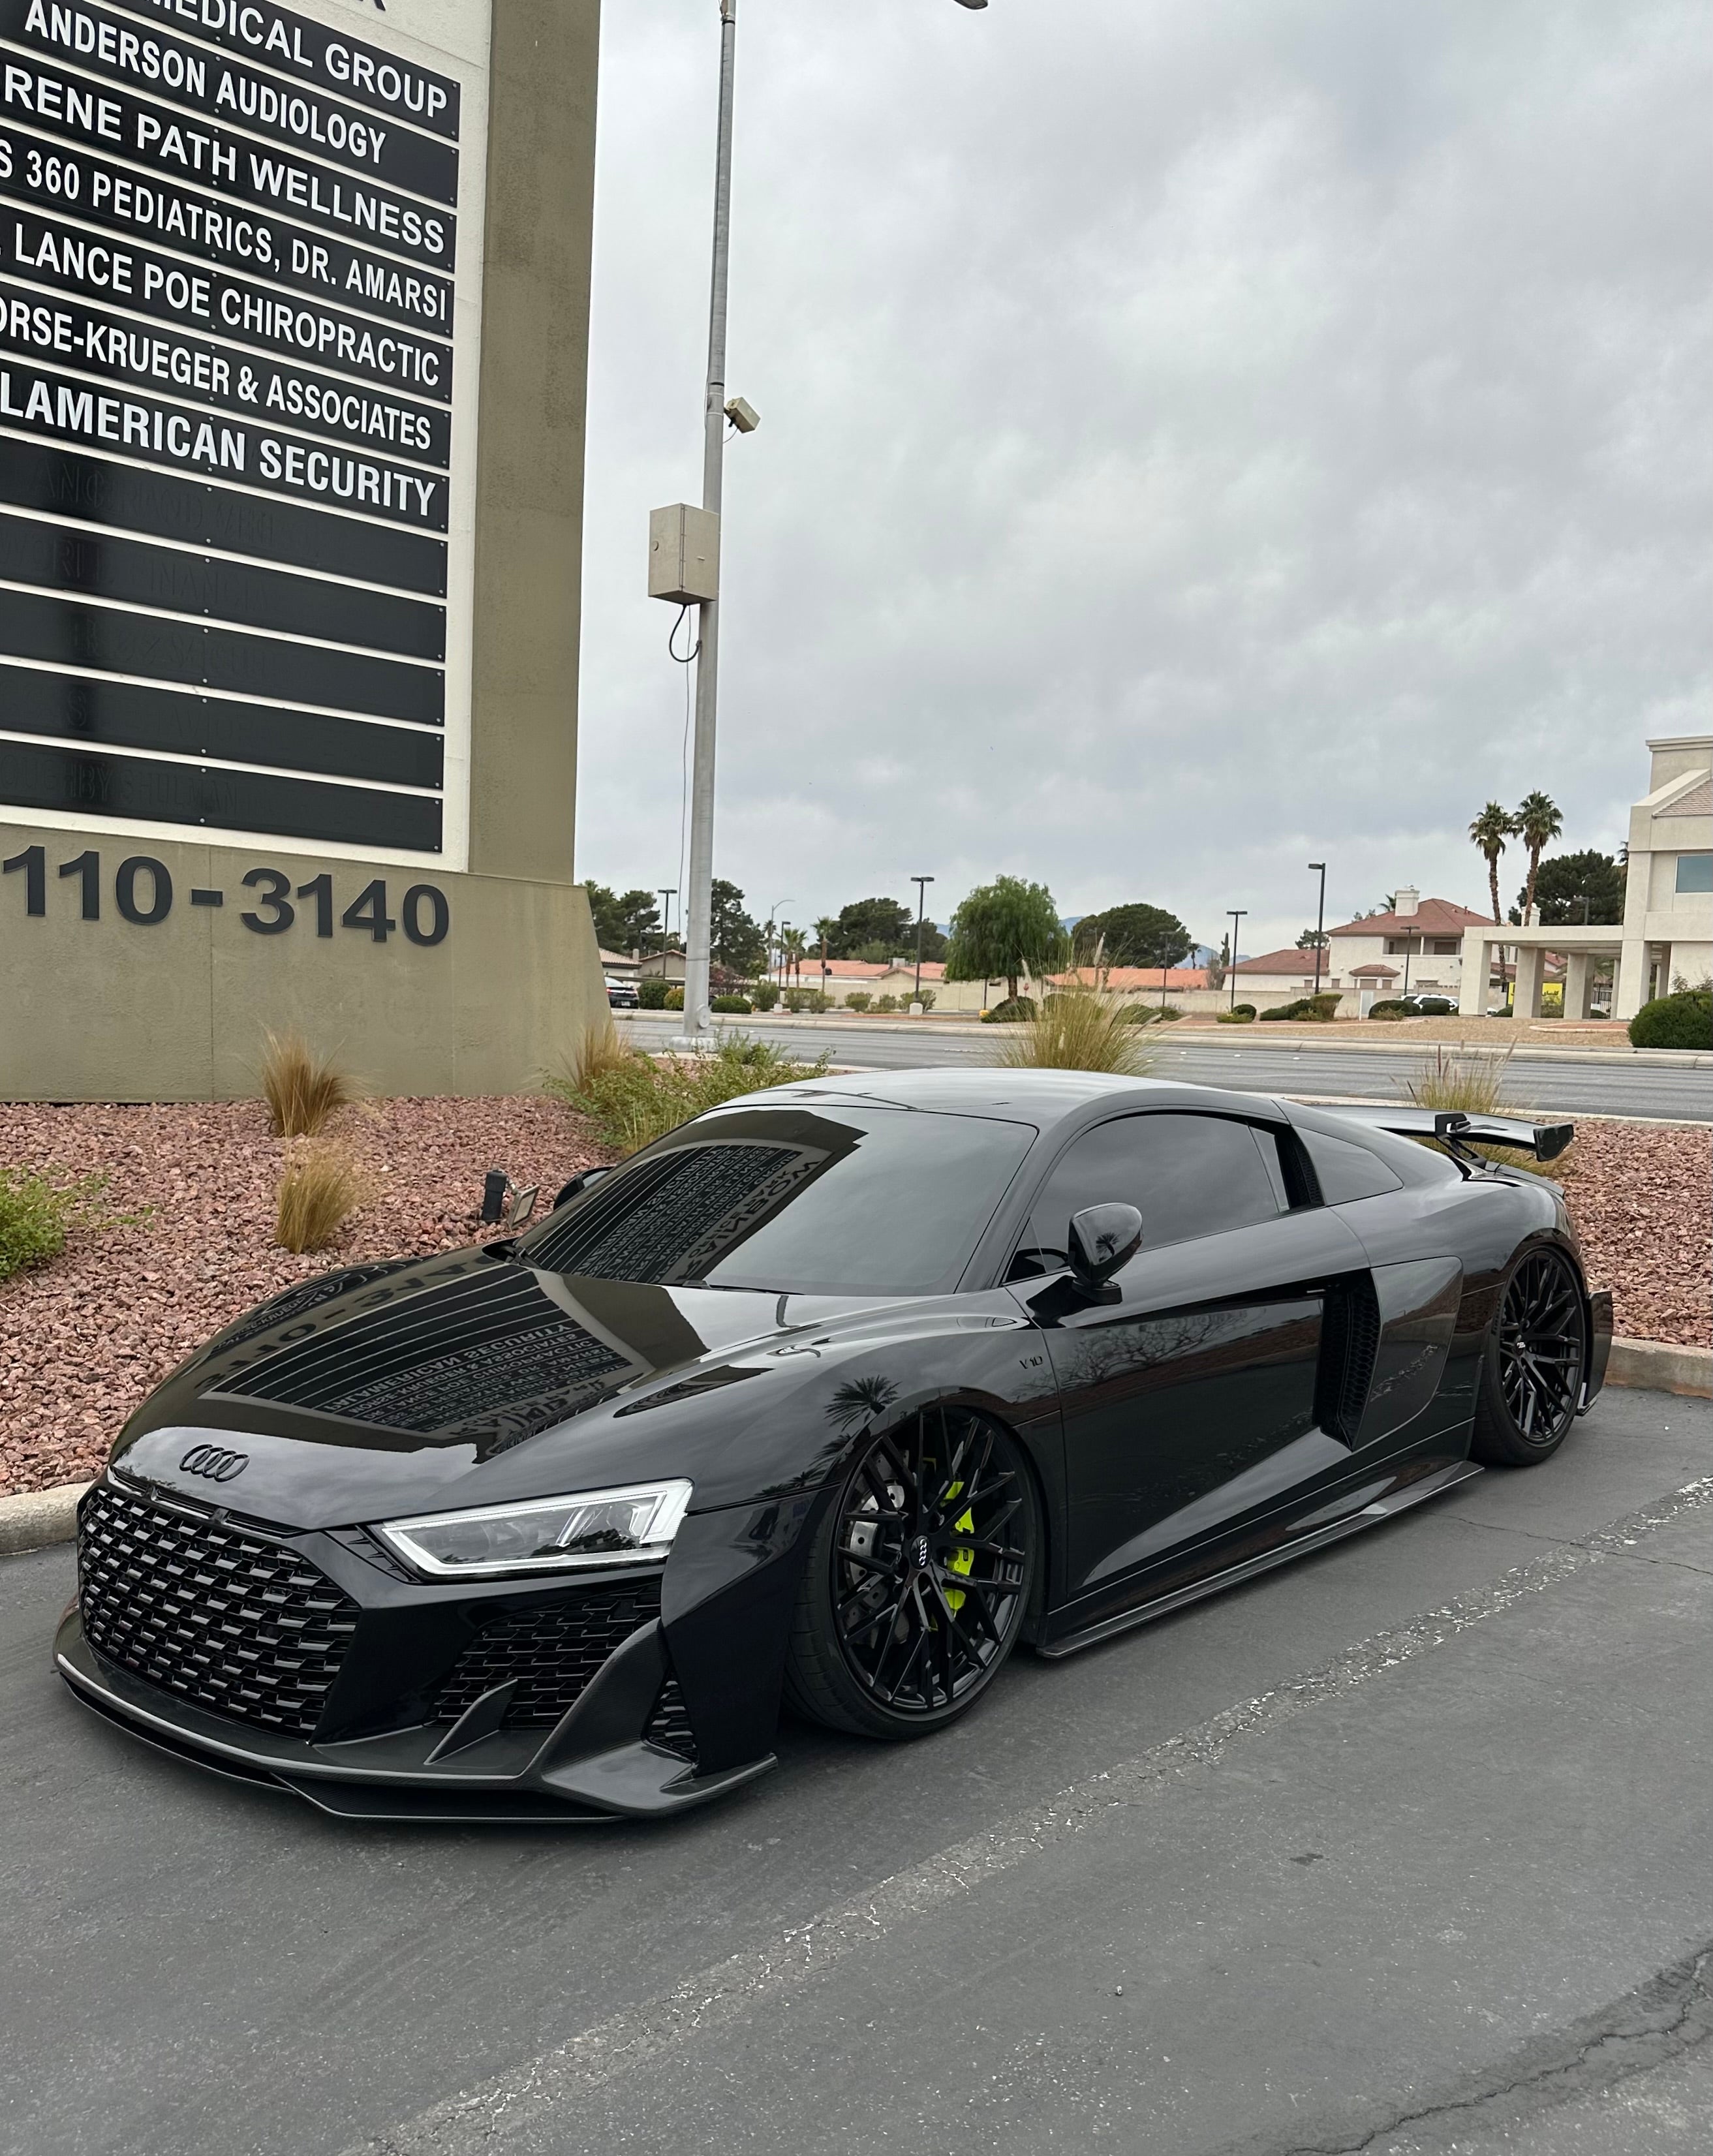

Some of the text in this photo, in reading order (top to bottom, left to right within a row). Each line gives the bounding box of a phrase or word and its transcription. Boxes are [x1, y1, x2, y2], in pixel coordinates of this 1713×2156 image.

[24, 0, 386, 164] ANDERSON AUDIOLOGY
[145, 0, 447, 118] EDICAL GROUP
[5, 64, 444, 253] RENE PATH WELLNESS
[26, 150, 80, 200] 360
[93, 171, 281, 273] PEDIATRICS,
[292, 238, 337, 285] DR.
[345, 258, 446, 320] AMARSI
[15, 223, 439, 386] LANCE POE CHIROPRACTIC
[0, 371, 245, 471] LAMERICAN
[260, 439, 436, 516] SECURITY
[238, 365, 259, 404] &
[266, 374, 431, 450] ASSOCIATES
